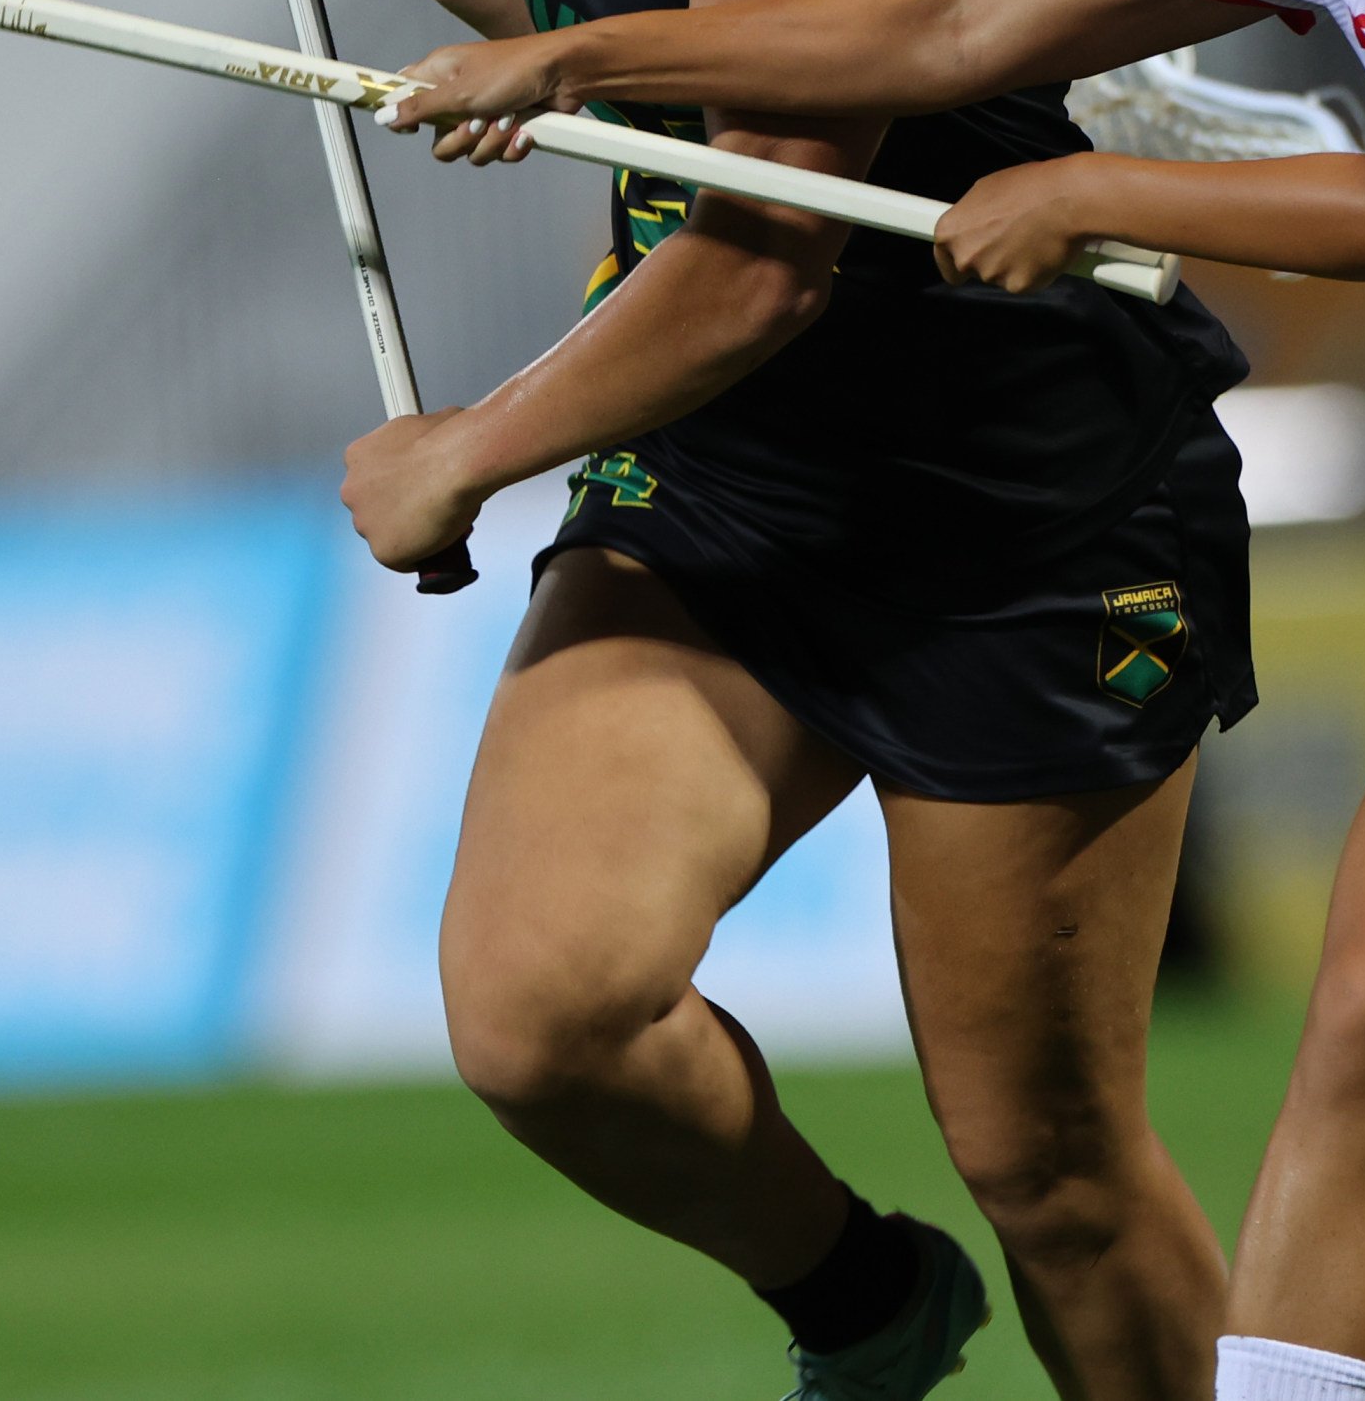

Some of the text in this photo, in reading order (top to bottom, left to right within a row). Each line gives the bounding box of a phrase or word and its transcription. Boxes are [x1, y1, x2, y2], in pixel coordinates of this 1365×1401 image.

[258, 61, 340, 95] ARIA
[358, 254, 386, 354] MIDSIZE DIAMETER
[1112, 586, 1174, 607] JAMAICA
